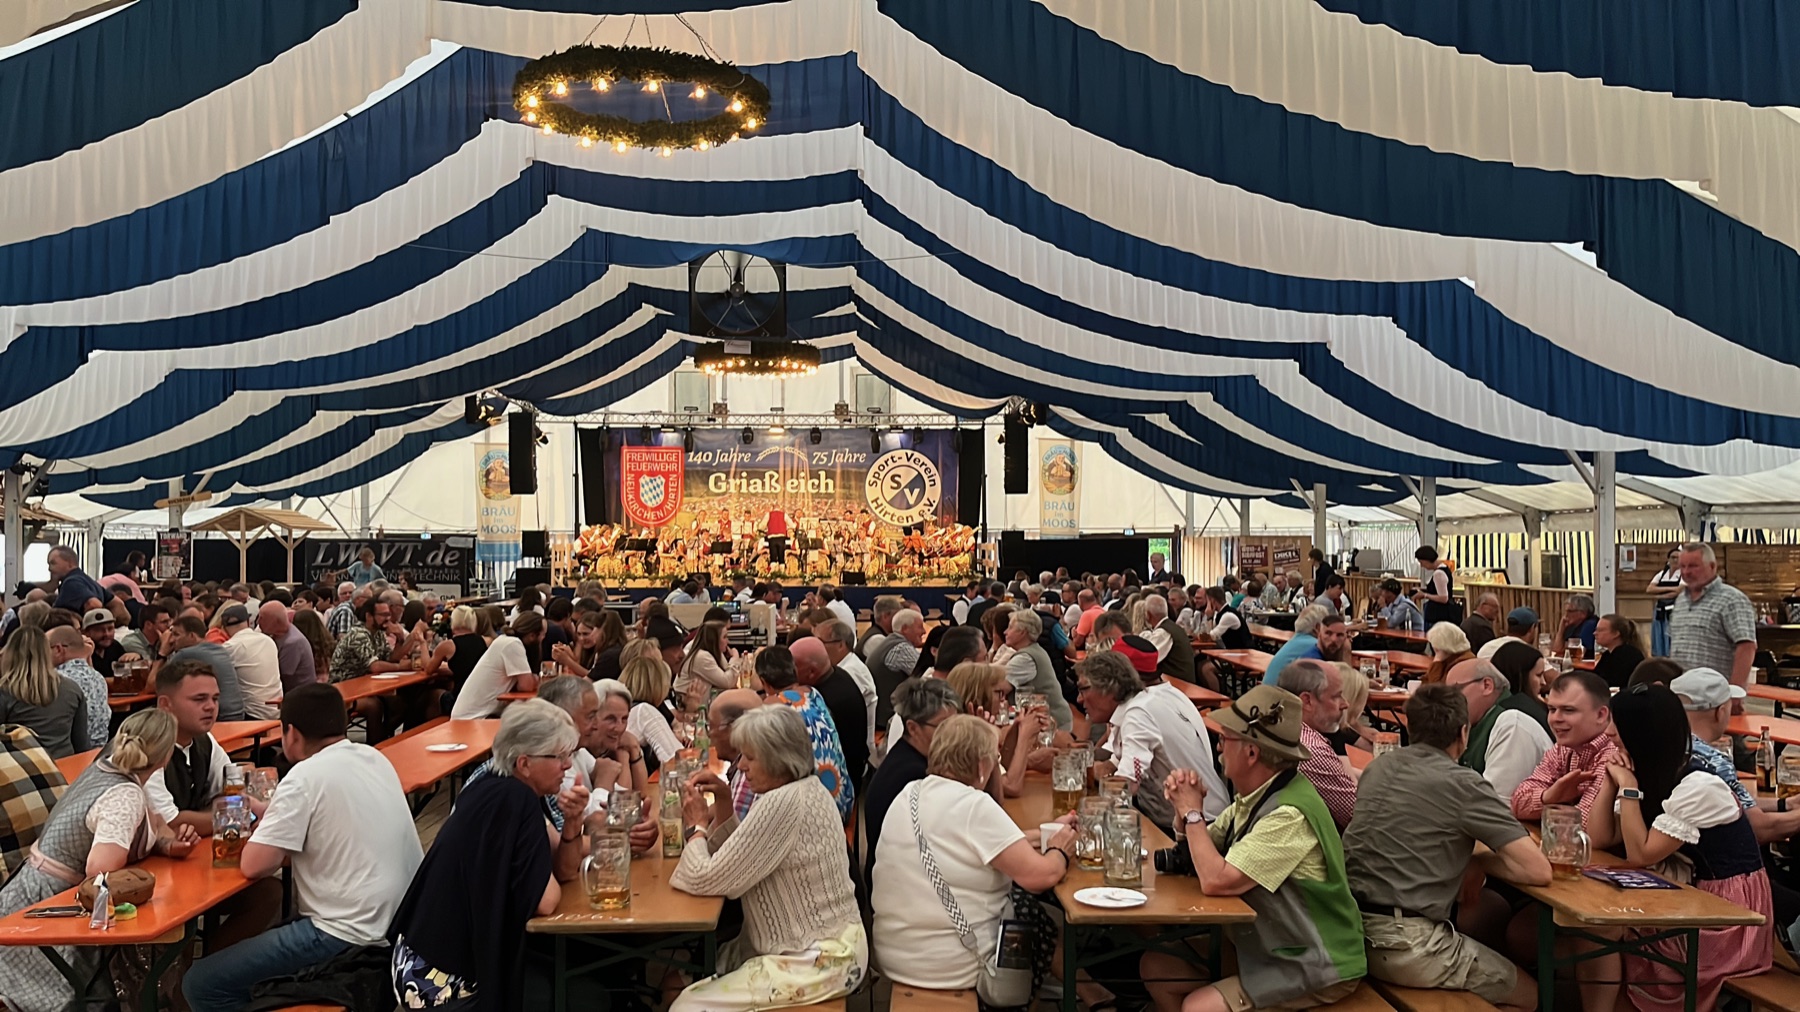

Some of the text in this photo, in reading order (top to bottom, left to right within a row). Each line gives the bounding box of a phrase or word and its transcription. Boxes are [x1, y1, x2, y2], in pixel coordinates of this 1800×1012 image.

[626, 452, 678, 462] FREIWILLIGE
[687, 449, 752, 465] 140 Jahre
[812, 449, 867, 465] 75 Jahre
[626, 462, 678, 472] FEUERWEHR
[868, 452, 937, 488] Sport-Verein
[708, 470, 835, 493] Griaß eich
[626, 473, 678, 520] NEUKIRCHEN/HIRTEN
[481, 505, 516, 517] BRÄU
[871, 497, 915, 524] Hirten
[1043, 499, 1075, 511] BRÄU
[480, 525, 517, 535] MOOS
[1042, 519, 1077, 529] MOOS
[311, 541, 461, 568] LWVT.de
